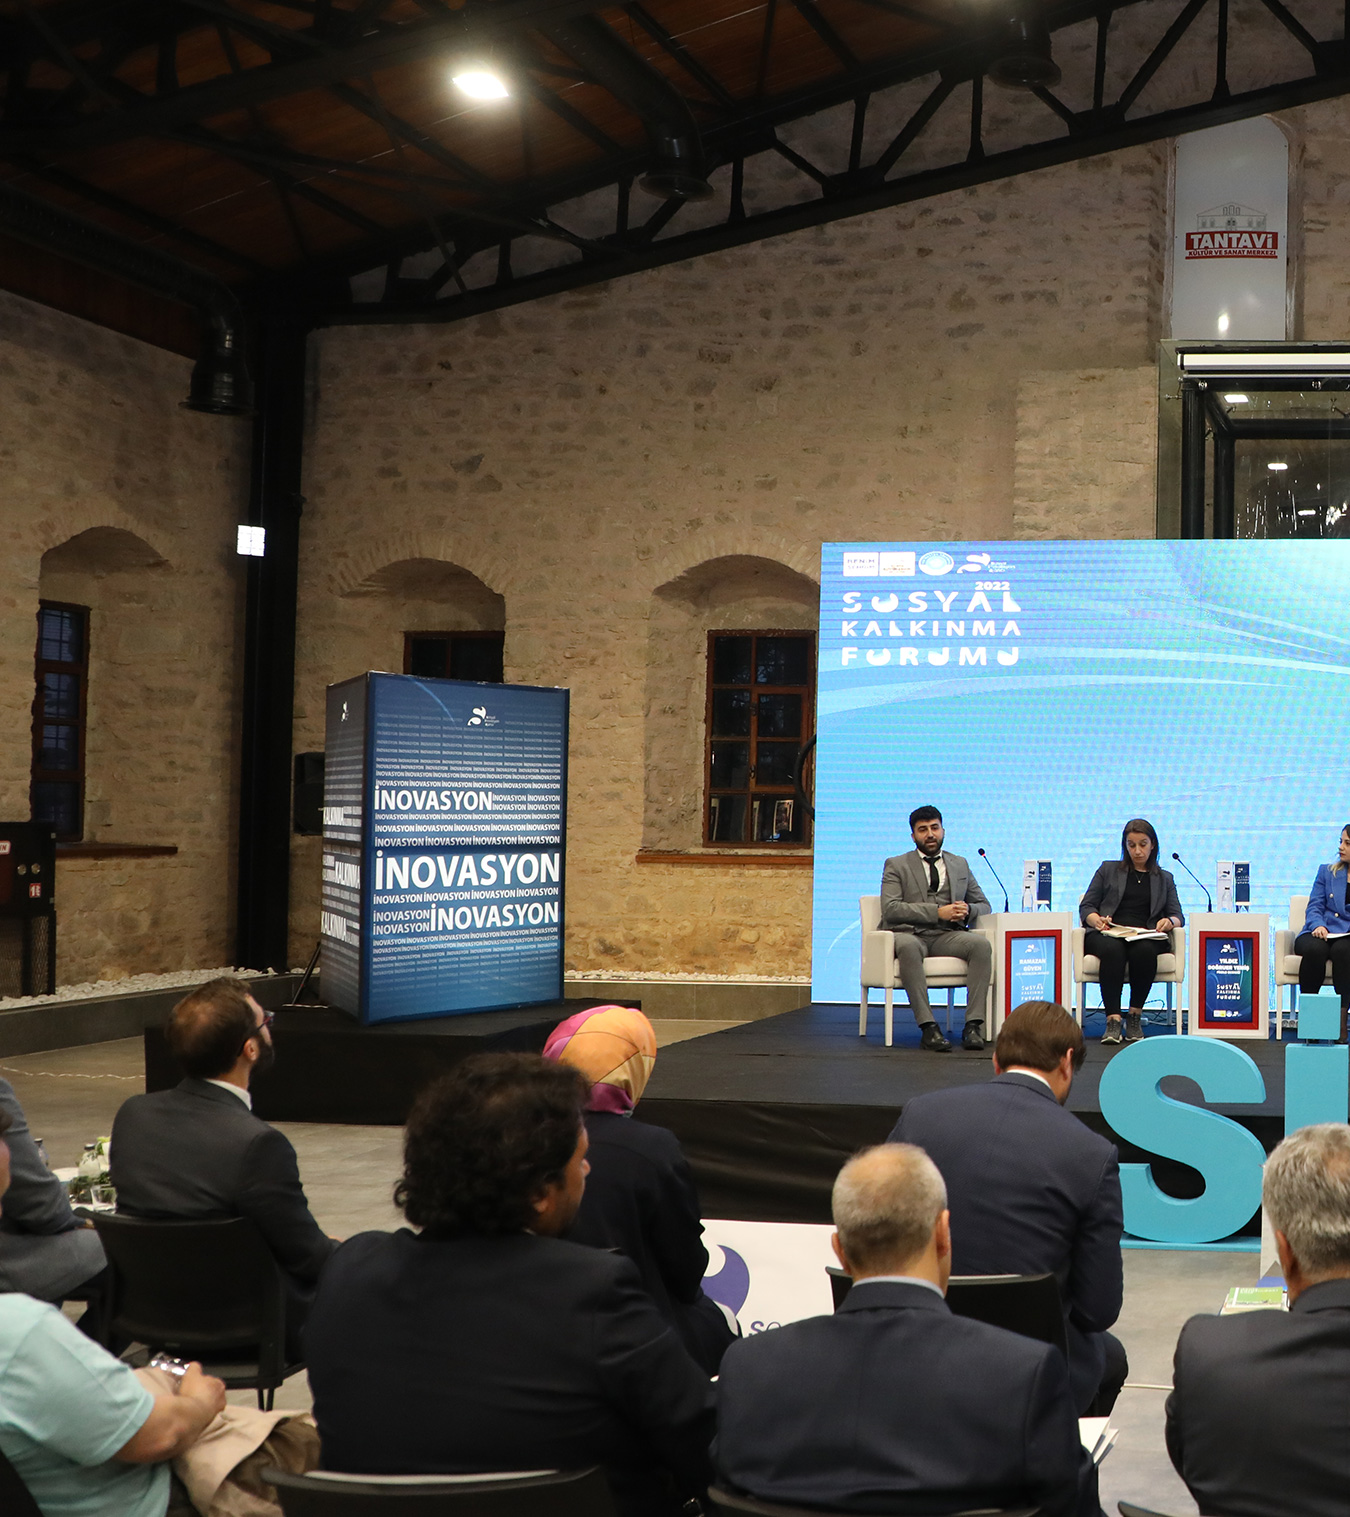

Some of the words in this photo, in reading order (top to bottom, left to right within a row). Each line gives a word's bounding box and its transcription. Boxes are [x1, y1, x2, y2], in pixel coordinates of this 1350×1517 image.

[1191, 234, 1272, 248] TANTAVİ
[975, 582, 1010, 590] 2022
[842, 621, 1021, 637] KALKINMA
[842, 647, 1019, 666] FORUMU
[374, 785, 492, 810] İNOVASYON
[375, 824, 415, 832] İNOVASYON
[416, 823, 453, 832] İNOVASYON
[454, 823, 491, 831] İNOVASYON
[491, 823, 526, 831] İNOVASYON
[527, 822, 560, 831] İNOVASYON
[375, 837, 424, 847] İNOVASYON
[425, 836, 471, 846] İNOVASYON
[473, 835, 517, 845] İNOVASYON
[518, 835, 560, 844] İNOVASYON
[375, 850, 560, 890] İNOVASYON
[373, 894, 422, 904] İNOVASYON
[424, 892, 470, 901] İNOVASYON
[472, 889, 515, 898] İNOVASYON
[517, 887, 558, 895] İNOVASYON
[373, 910, 430, 922] İNOVASYON
[430, 902, 558, 931] İNOVASYON
[373, 922, 429, 935] İNOVASYON
